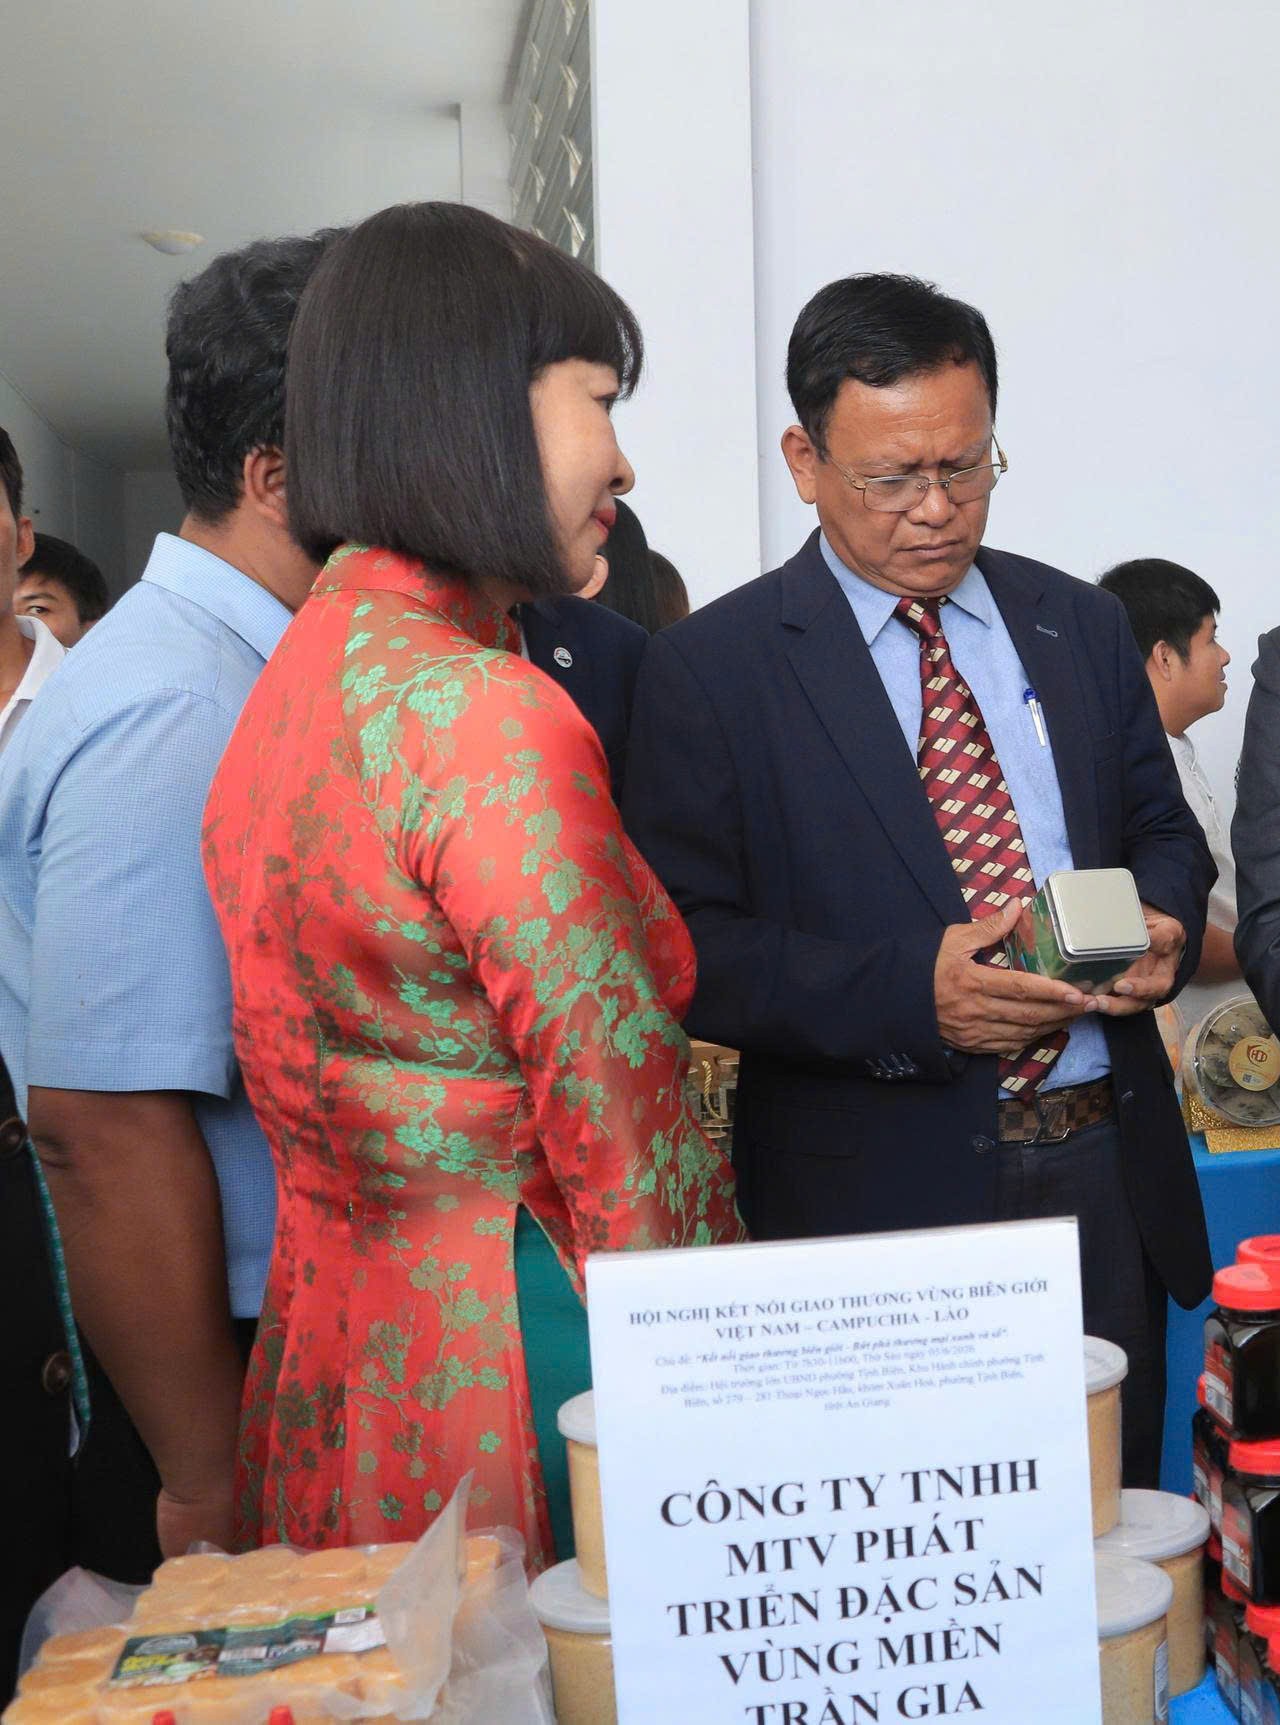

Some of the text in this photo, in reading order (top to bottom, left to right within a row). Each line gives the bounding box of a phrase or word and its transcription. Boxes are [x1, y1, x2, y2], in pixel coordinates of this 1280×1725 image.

[629, 1277, 1048, 1326] HỘI NGHỊ KẾT NỐI GIAO THƯƠNG VÙNG BIÊN GIỚI
[715, 1325, 758, 1341] VIỆT
[761, 1322, 800, 1337] NAM
[817, 1312, 920, 1332] CAMPUCHIA
[934, 1305, 969, 1322] LÀO
[660, 1458, 1040, 1528] CÔNG TY TNHH
[725, 1513, 985, 1577] MTV PHÁT
[666, 1560, 1044, 1638] TRIỂN ĐẶC SẢN
[720, 1617, 1004, 1686] VÙNG MIỀN
[745, 1679, 986, 1725] TRẦN GIA
